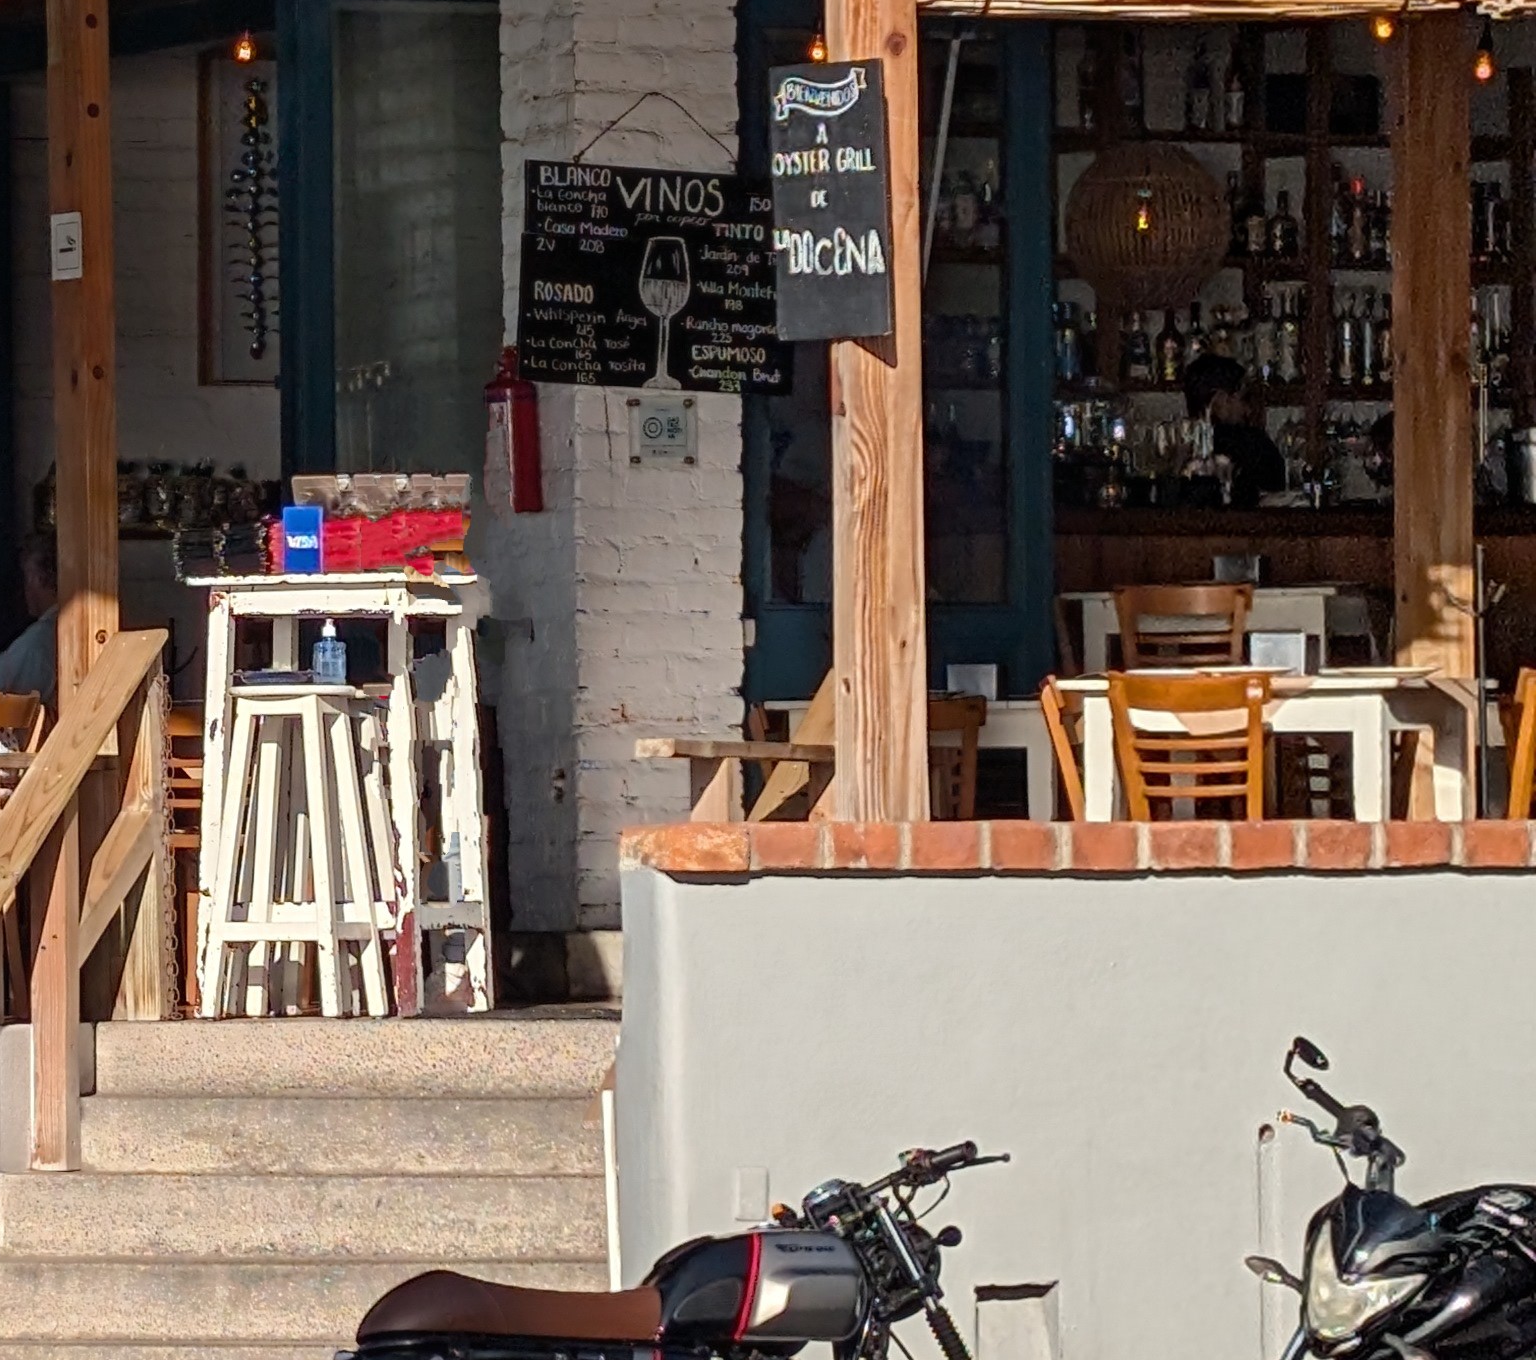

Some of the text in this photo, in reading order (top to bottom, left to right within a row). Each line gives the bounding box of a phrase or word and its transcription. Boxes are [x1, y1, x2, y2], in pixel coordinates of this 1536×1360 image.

[816, 122, 828, 144] A
[772, 147, 877, 176] OYSTER GRILL
[539, 166, 611, 187] BLANCO
[537, 185, 607, 203] La Concha
[615, 175, 724, 217] VINOS
[810, 190, 828, 208] DE
[544, 216, 629, 237] Casa Madero
[712, 223, 764, 241] TINTO
[773, 229, 790, 251] LA
[789, 226, 886, 275] DOCENA
[534, 280, 594, 304] ROSADO
[691, 345, 766, 364] ESPUMOSO
[286, 535, 318, 549] VISA
